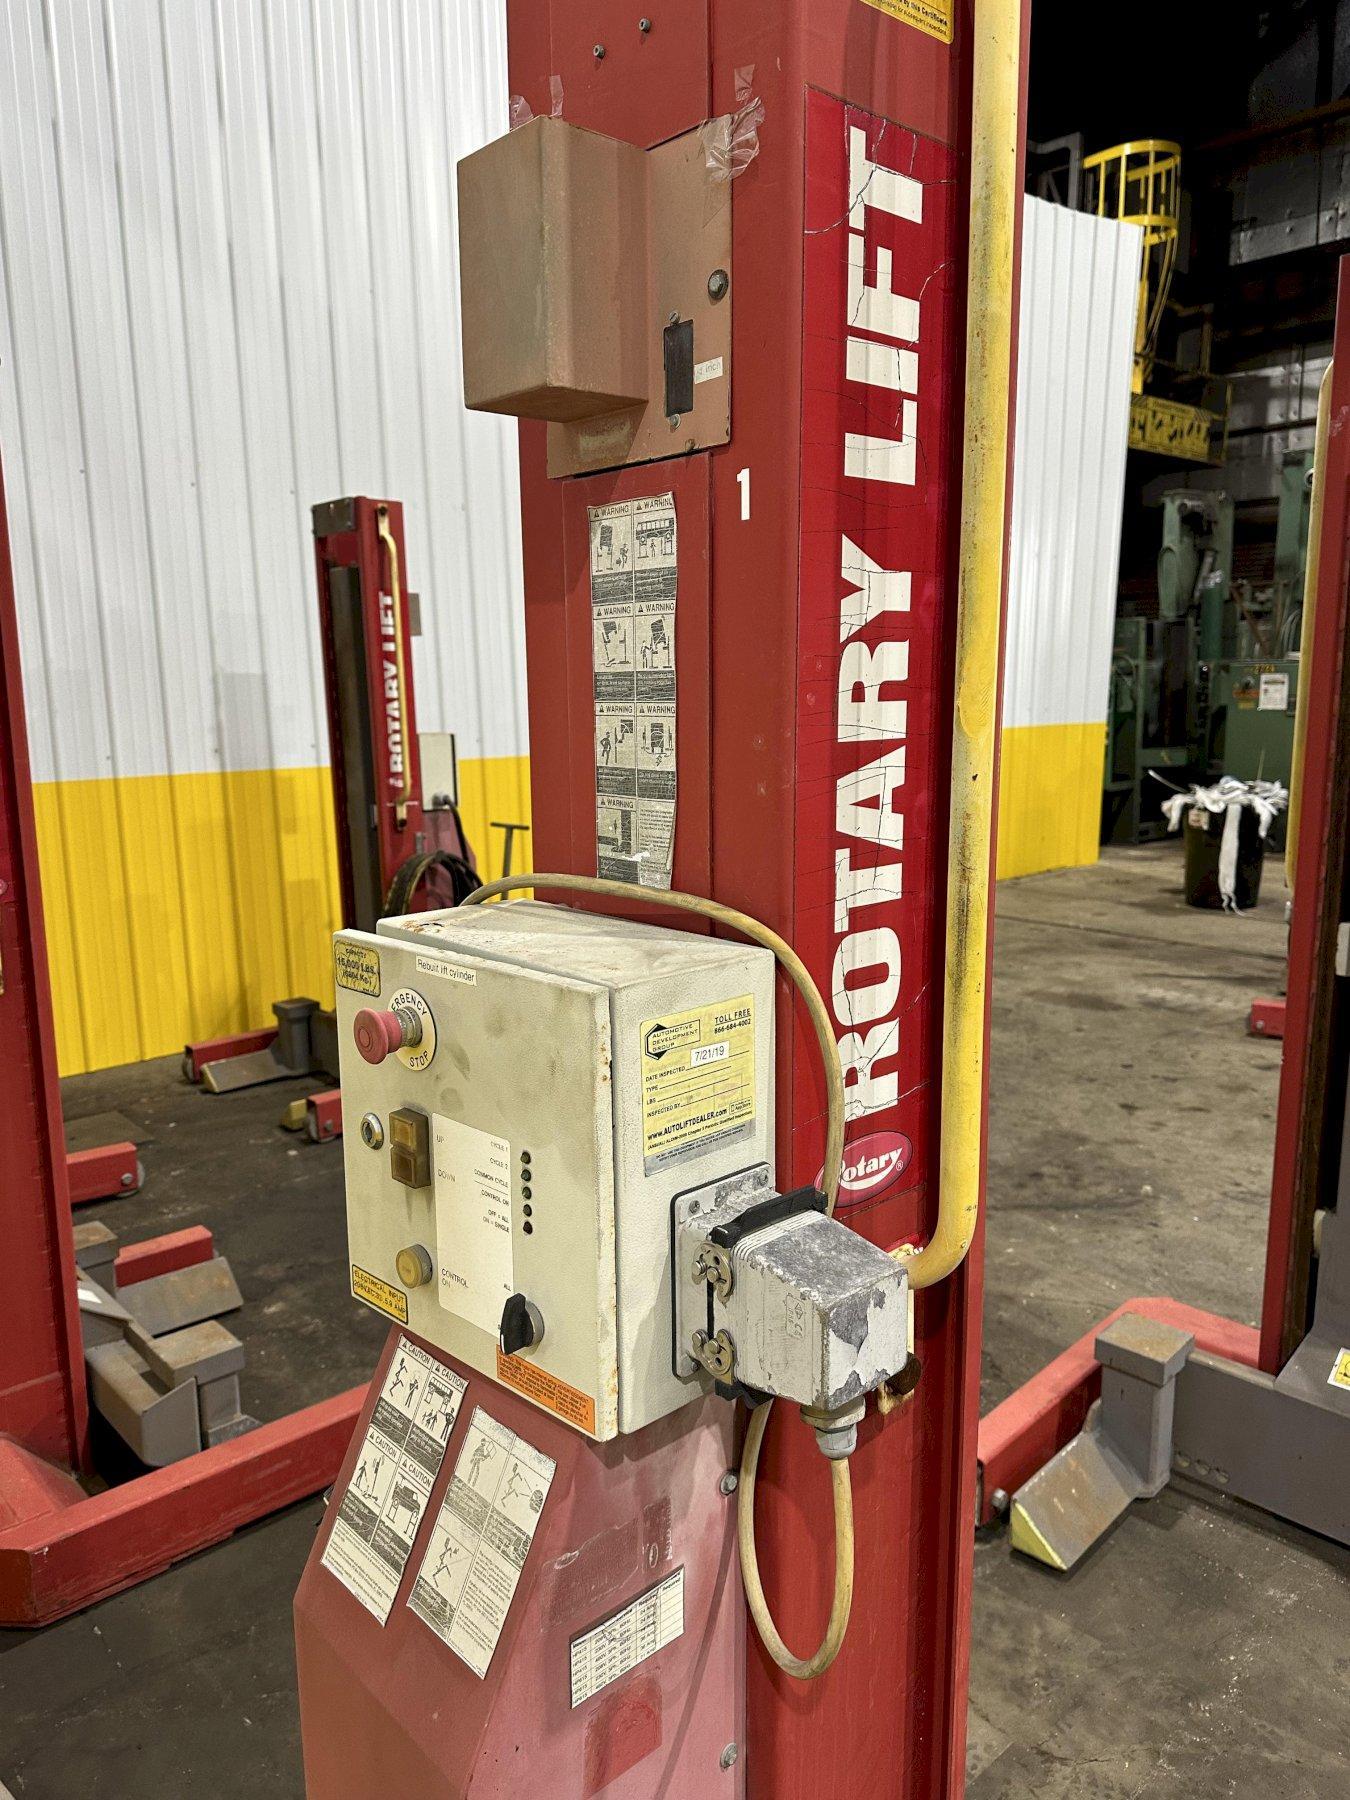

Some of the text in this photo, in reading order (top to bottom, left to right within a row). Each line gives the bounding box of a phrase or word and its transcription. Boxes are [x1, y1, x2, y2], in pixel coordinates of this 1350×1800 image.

[845, 125, 923, 486] LIFT
[737, 468, 750, 521] 1
[602, 505, 630, 516] WARNING
[603, 606, 631, 616] WARNING
[645, 602, 675, 613] WARNING
[605, 705, 633, 714] WARNING
[646, 704, 676, 714] WARNING
[607, 797, 634, 809] WARNING
[832, 533, 912, 1123] ROTARY
[417, 958, 475, 983] Rebuilt lift cylinder
[391, 992, 428, 1016] ERGENCY
[714, 1008, 751, 1024] TOLL FREE
[652, 1023, 693, 1039] AUTOMOTIVE
[652, 1029, 698, 1046] DEVELOPMENT
[652, 1042, 675, 1053] GROUP
[695, 1046, 725, 1062] 7/21/19
[409, 1050, 429, 1068] STOP
[645, 1066, 686, 1082] DATE INSPECTED
[646, 1085, 659, 1093] TYPE
[647, 1102, 681, 1118] INSPECTED BY
[647, 1108, 728, 1141] www.AUTOLIFTDEALER.com
[436, 1134, 444, 1144] UP
[490, 1141, 505, 1152] CYCLE
[489, 1157, 504, 1168] CYCLE
[838, 1147, 902, 1189] otary
[437, 1169, 456, 1182] DOWN
[473, 1168, 508, 1188] COMMON CYCLE
[481, 1189, 501, 1203] CONTROL
[488, 1209, 496, 1218] OFF
[501, 1215, 509, 1223] ALL
[482, 1216, 490, 1224] ON
[494, 1221, 510, 1233] SINGLE
[441, 1268, 469, 1289] CONTROL
[441, 1277, 451, 1288] ON
[354, 1270, 387, 1294] ELECTRICAL
[388, 1289, 404, 1304] INPUT
[408, 1344, 431, 1366] CAUTION
[441, 1368, 465, 1389] CAUTION
[375, 1435, 398, 1459] CAUTION
[408, 1465, 432, 1489] CAUTION
